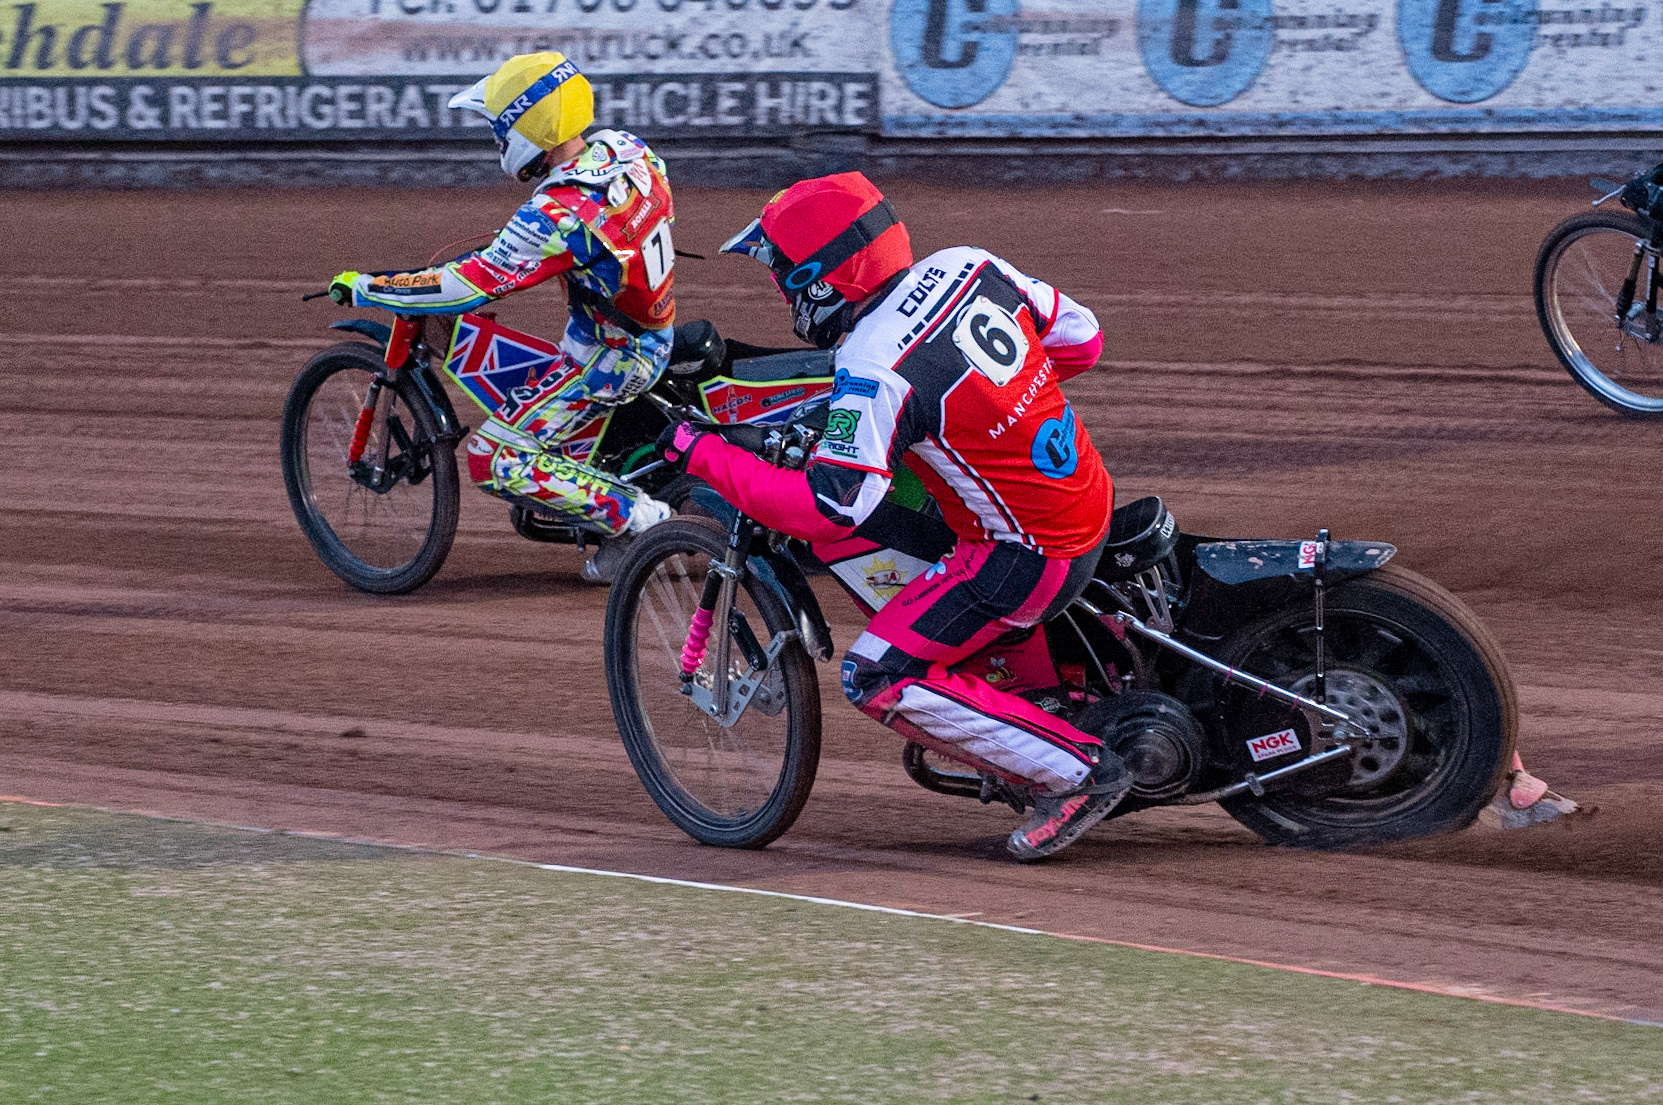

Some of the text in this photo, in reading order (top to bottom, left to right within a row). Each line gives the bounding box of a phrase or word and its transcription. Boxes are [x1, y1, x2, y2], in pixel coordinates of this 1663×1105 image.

[0, 2, 257, 70] hdale
[127, 85, 164, 130] &
[171, 85, 488, 129] REFRIGERAT
[595, 82, 748, 127] HICLE
[755, 82, 872, 126] HIRE
[631, 200, 652, 229] ROYALS
[650, 231, 665, 275] 7
[412, 274, 439, 286] Park
[896, 266, 947, 318] COLTS
[969, 312, 1018, 368] 6
[988, 356, 1053, 440] MANCHEST
[1251, 731, 1295, 755] NGK
